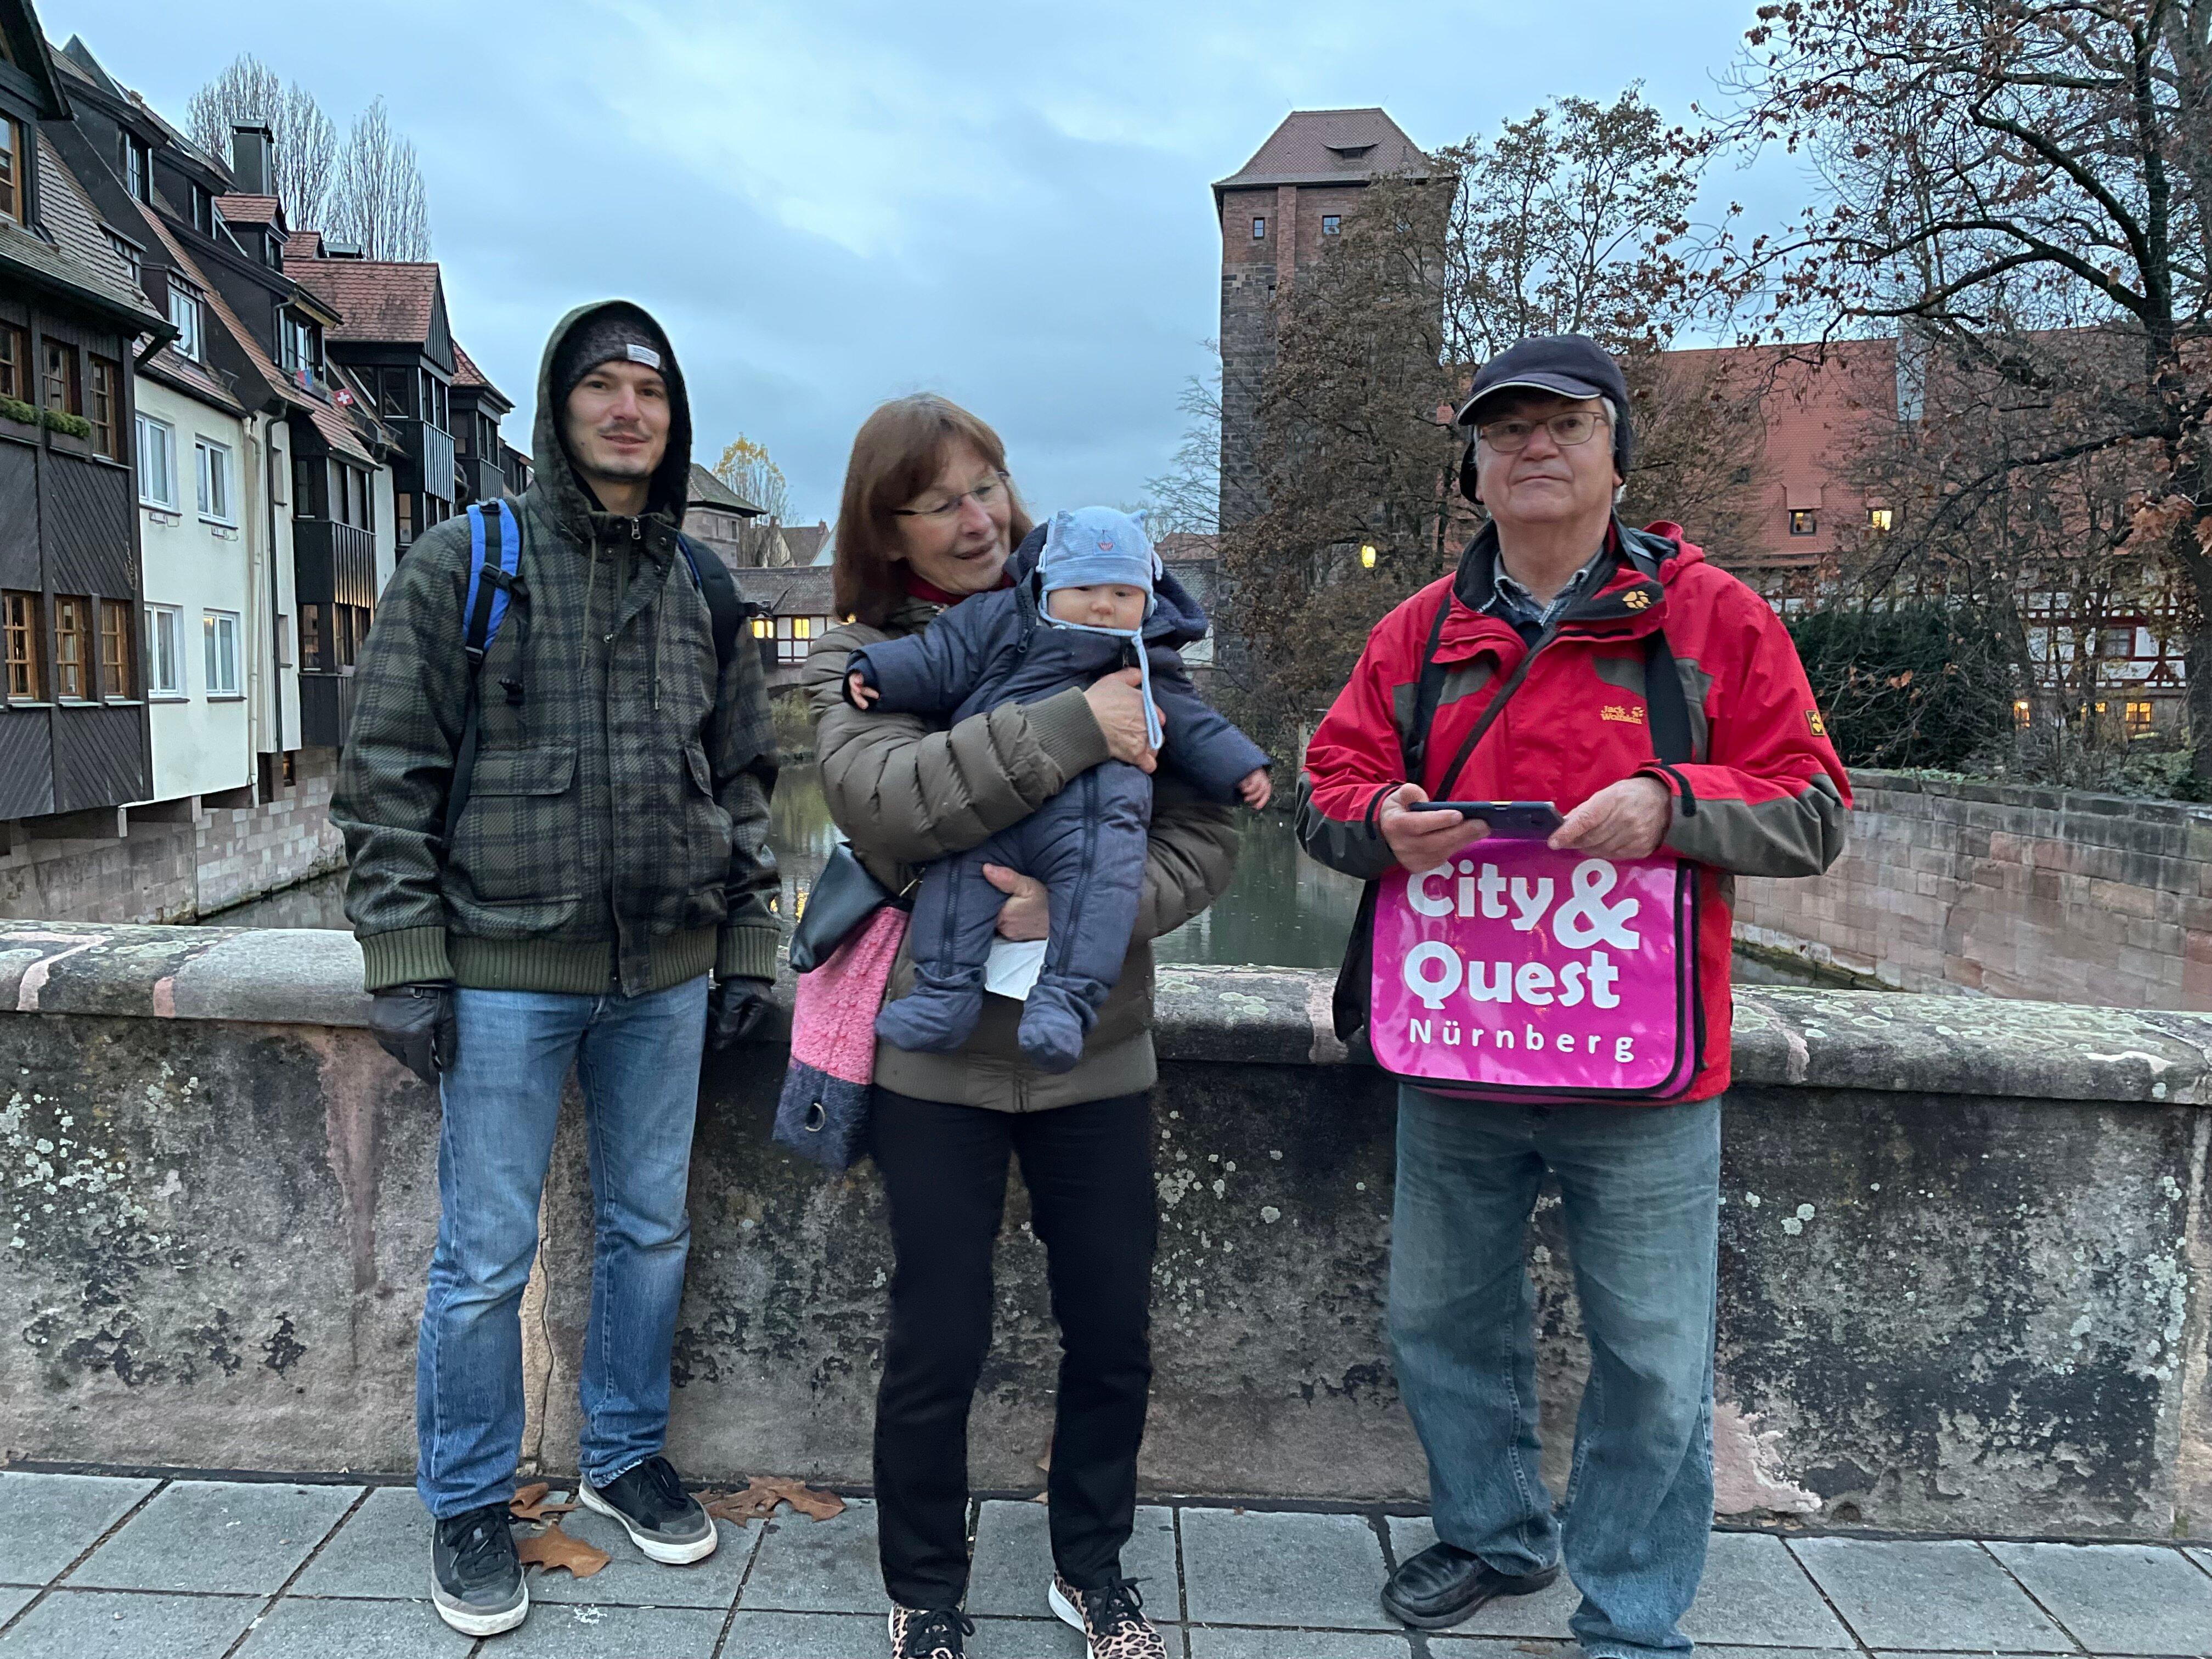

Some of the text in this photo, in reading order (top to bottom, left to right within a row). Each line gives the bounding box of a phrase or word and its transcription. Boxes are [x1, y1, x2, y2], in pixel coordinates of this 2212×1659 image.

[1601, 705, 1626, 714] Jack
[1404, 941, 1620, 1009] Quest
[1410, 1018, 1634, 1063] Nürnberg
